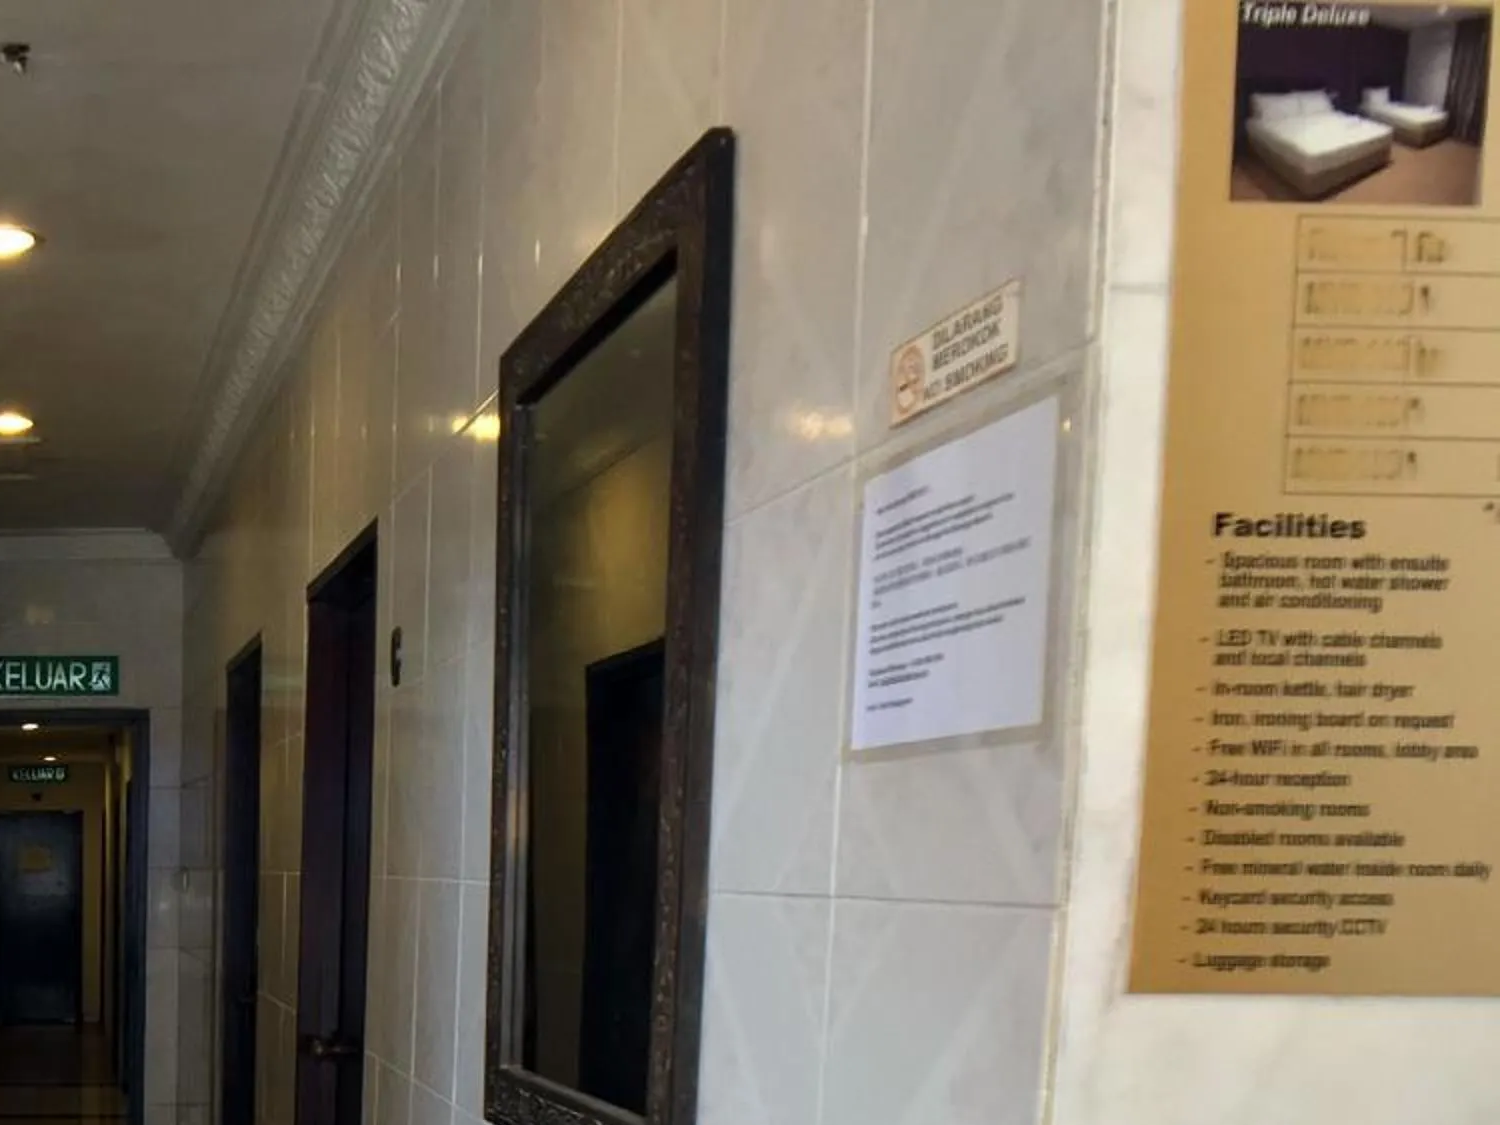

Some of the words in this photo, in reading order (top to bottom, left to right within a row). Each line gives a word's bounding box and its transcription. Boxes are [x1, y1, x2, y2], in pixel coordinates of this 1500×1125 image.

[1243, 1, 1297, 28] Triple
[1302, 4, 1371, 26] Deluxe
[932, 295, 1004, 349] DILARANG
[932, 322, 1000, 370] MEROKOK
[945, 342, 1009, 391] SMOKING
[1213, 513, 1367, 538] Facilities
[1224, 552, 1298, 571] Spacious
[1304, 556, 1346, 569] room
[1352, 555, 1384, 570] with
[1310, 575, 1336, 589] hot
[1342, 576, 1386, 589] water
[1388, 575, 1450, 591] shower
[1217, 593, 1249, 608] and
[1254, 594, 1274, 608] air
[1216, 629, 1251, 647] LED
[1258, 630, 1280, 646] TV
[1284, 631, 1316, 647] with
[1322, 632, 1364, 648] cable
[1369, 632, 1443, 649] channels
[1213, 650, 1246, 666] and
[1251, 650, 1290, 666] local
[1294, 651, 1367, 667] channels
[1336, 681, 1367, 697] hair
[1372, 683, 1415, 701] dryer
[1255, 711, 1311, 731] ironing
[1316, 712, 1364, 727] board
[1368, 714, 1388, 727] on
[1394, 713, 1455, 730] request
[1208, 739, 1245, 756] Free
[1292, 742, 1308, 756] in
[1310, 741, 1330, 757] all
[1395, 743, 1439, 761] lobby
[1444, 746, 1478, 759] area
[1276, 773, 1351, 789] reception
[1320, 804, 1370, 817] rooms
[1203, 829, 1275, 846] Disabled
[1334, 833, 1405, 847] available
[1202, 859, 1238, 875] Free
[1243, 861, 1300, 875] mineral
[1308, 863, 1349, 876] water
[1408, 863, 1448, 877] room
[1454, 861, 1492, 881] daily
[1200, 888, 1266, 908] Keycard
[1271, 891, 1334, 909] security
[1338, 894, 1394, 906] access
[1195, 918, 1216, 935] 24
[1339, 919, 1388, 935] CCTV
[1193, 952, 1266, 972] Luggage
[1270, 954, 1330, 972] storage
